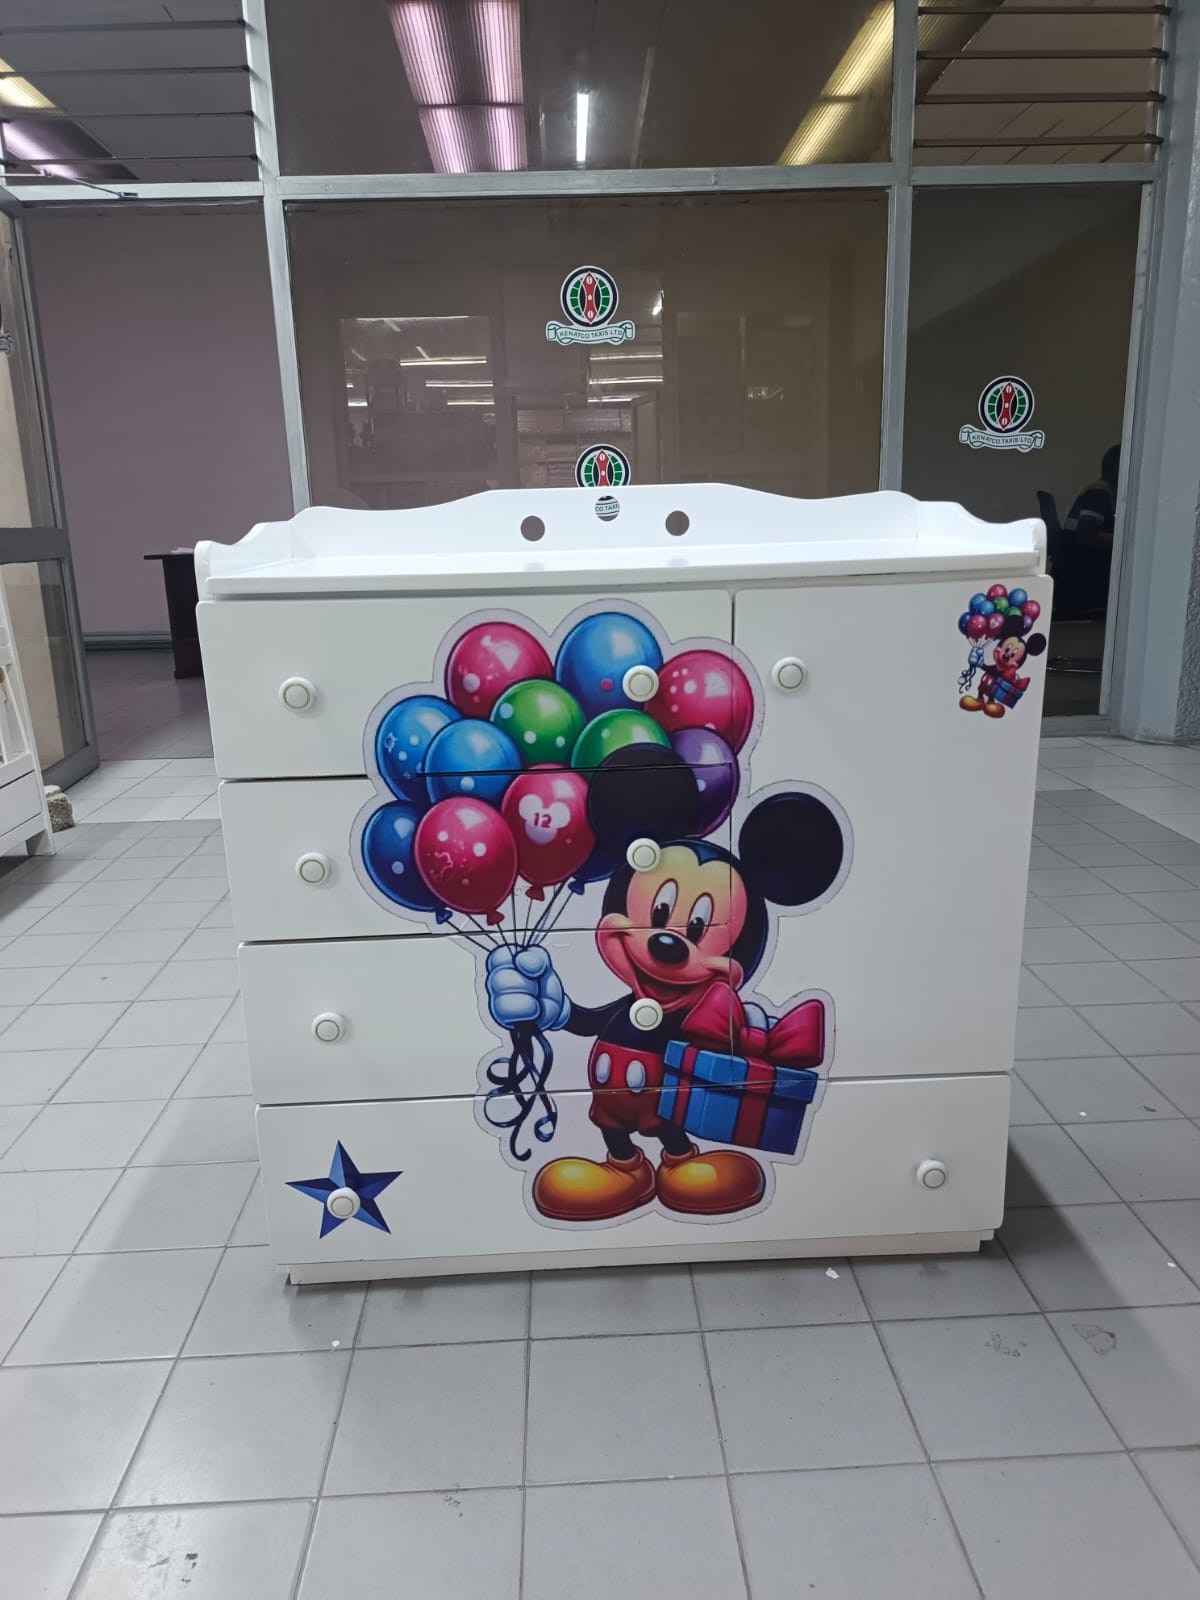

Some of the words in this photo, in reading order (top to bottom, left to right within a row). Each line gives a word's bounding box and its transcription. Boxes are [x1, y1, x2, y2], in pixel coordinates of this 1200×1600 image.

[559, 329, 590, 339] KENATCO
[591, 329, 609, 338] TAXIS
[610, 328, 623, 336] LTD
[972, 434, 1000, 444] KENATCO
[1002, 436, 1019, 444] TAXIS
[534, 812, 552, 829] 12
